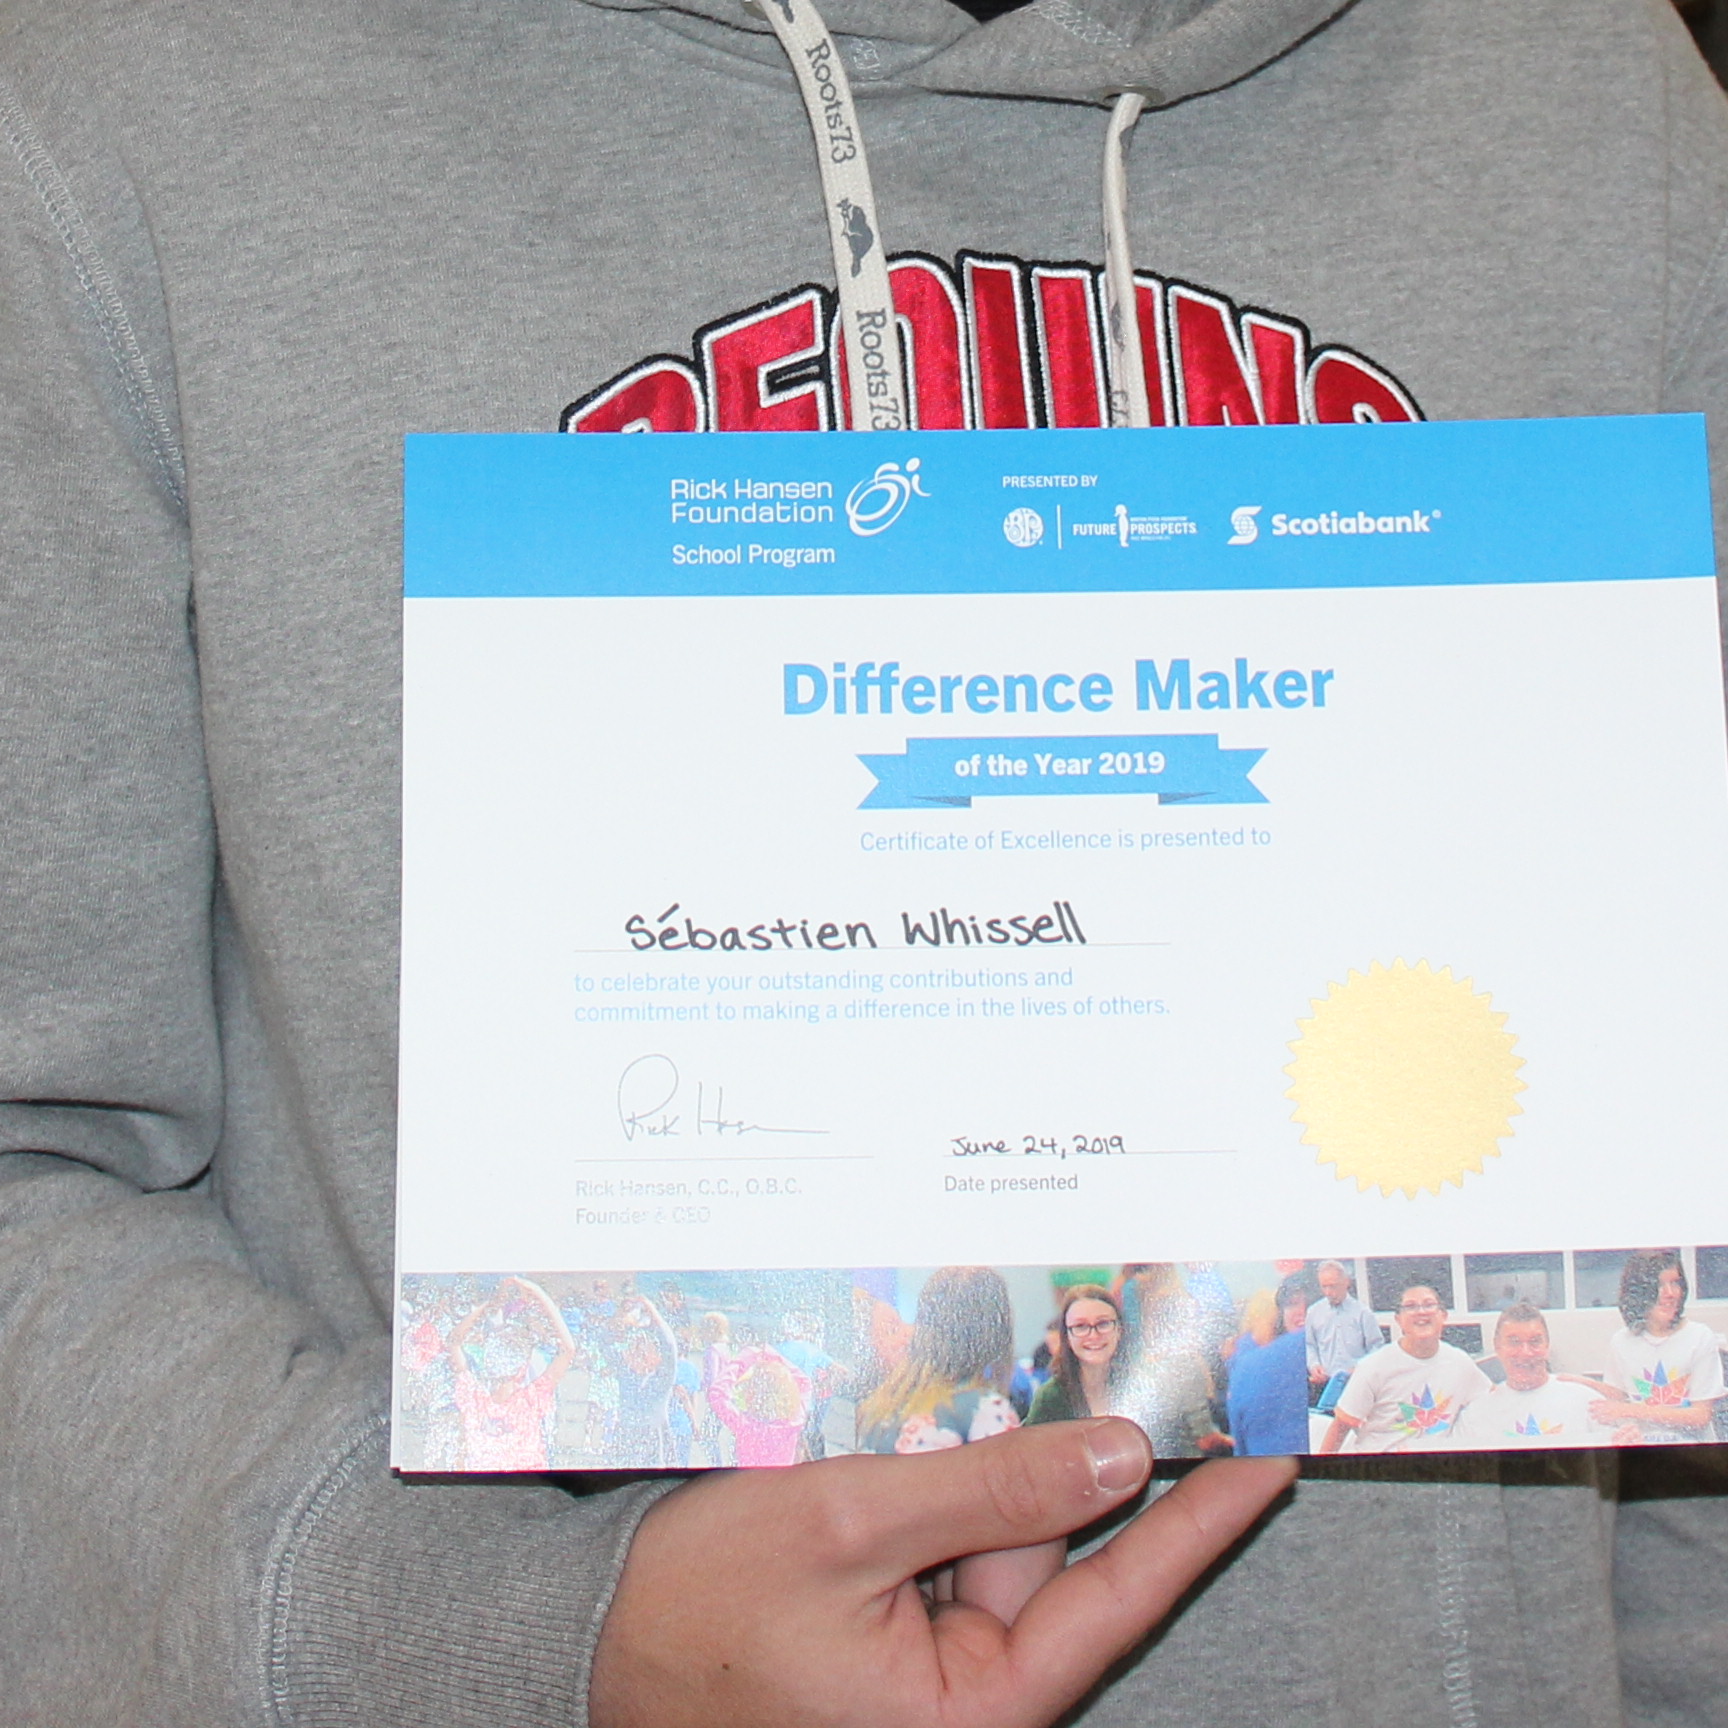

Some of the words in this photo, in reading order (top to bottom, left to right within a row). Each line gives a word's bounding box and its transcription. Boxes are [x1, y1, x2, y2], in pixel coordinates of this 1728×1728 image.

[805, 38, 856, 164] Roots73
[855, 307, 902, 431] Roots73
[671, 478, 727, 500] Rick
[734, 479, 833, 499] Hansen
[1002, 475, 1078, 488] PRESENTED
[1081, 475, 1098, 487] BY
[671, 501, 833, 523] Foundation
[1073, 523, 1117, 536] FUTURE
[1130, 522, 1198, 535] PROSPECTS
[671, 544, 741, 565] School
[748, 544, 835, 568] Program
[783, 661, 1114, 715] Difference
[1135, 657, 1334, 711] Maker
[954, 754, 981, 777] of
[986, 754, 1029, 777] the
[1034, 753, 1092, 776] Year
[1098, 752, 1165, 775] 2019
[860, 830, 969, 852] Certificate
[974, 829, 996, 850] of
[1001, 829, 1112, 850] Excellence
[1118, 828, 1135, 848] is
[1140, 826, 1245, 852] presented
[1251, 828, 1271, 846] to
[624, 903, 878, 951] Sébastien
[901, 900, 1087, 947] Whissell
[575, 974, 595, 992] to
[601, 972, 700, 992] celebrate
[706, 974, 753, 995] your
[758, 969, 884, 993] outstanding
[889, 968, 1029, 989] contributions
[1034, 967, 1073, 987] and
[574, 1001, 709, 1022] commitment
[716, 1002, 736, 1020] to
[742, 1000, 820, 1023] making
[826, 1003, 838, 1020] a
[844, 998, 951, 1020] difference
[956, 997, 975, 1017] in
[981, 997, 1016, 1017] the
[1022, 996, 1067, 1016] lives
[1073, 995, 1094, 1016] of
[1099, 994, 1171, 1015] others.
[950, 1136, 1012, 1157] June
[1022, 1135, 1066, 1160] 24,
[1072, 1134, 1126, 1155] 2019
[575, 1179, 614, 1197] Rick
[944, 1175, 985, 1192] Date
[990, 1174, 1079, 1194] presented
